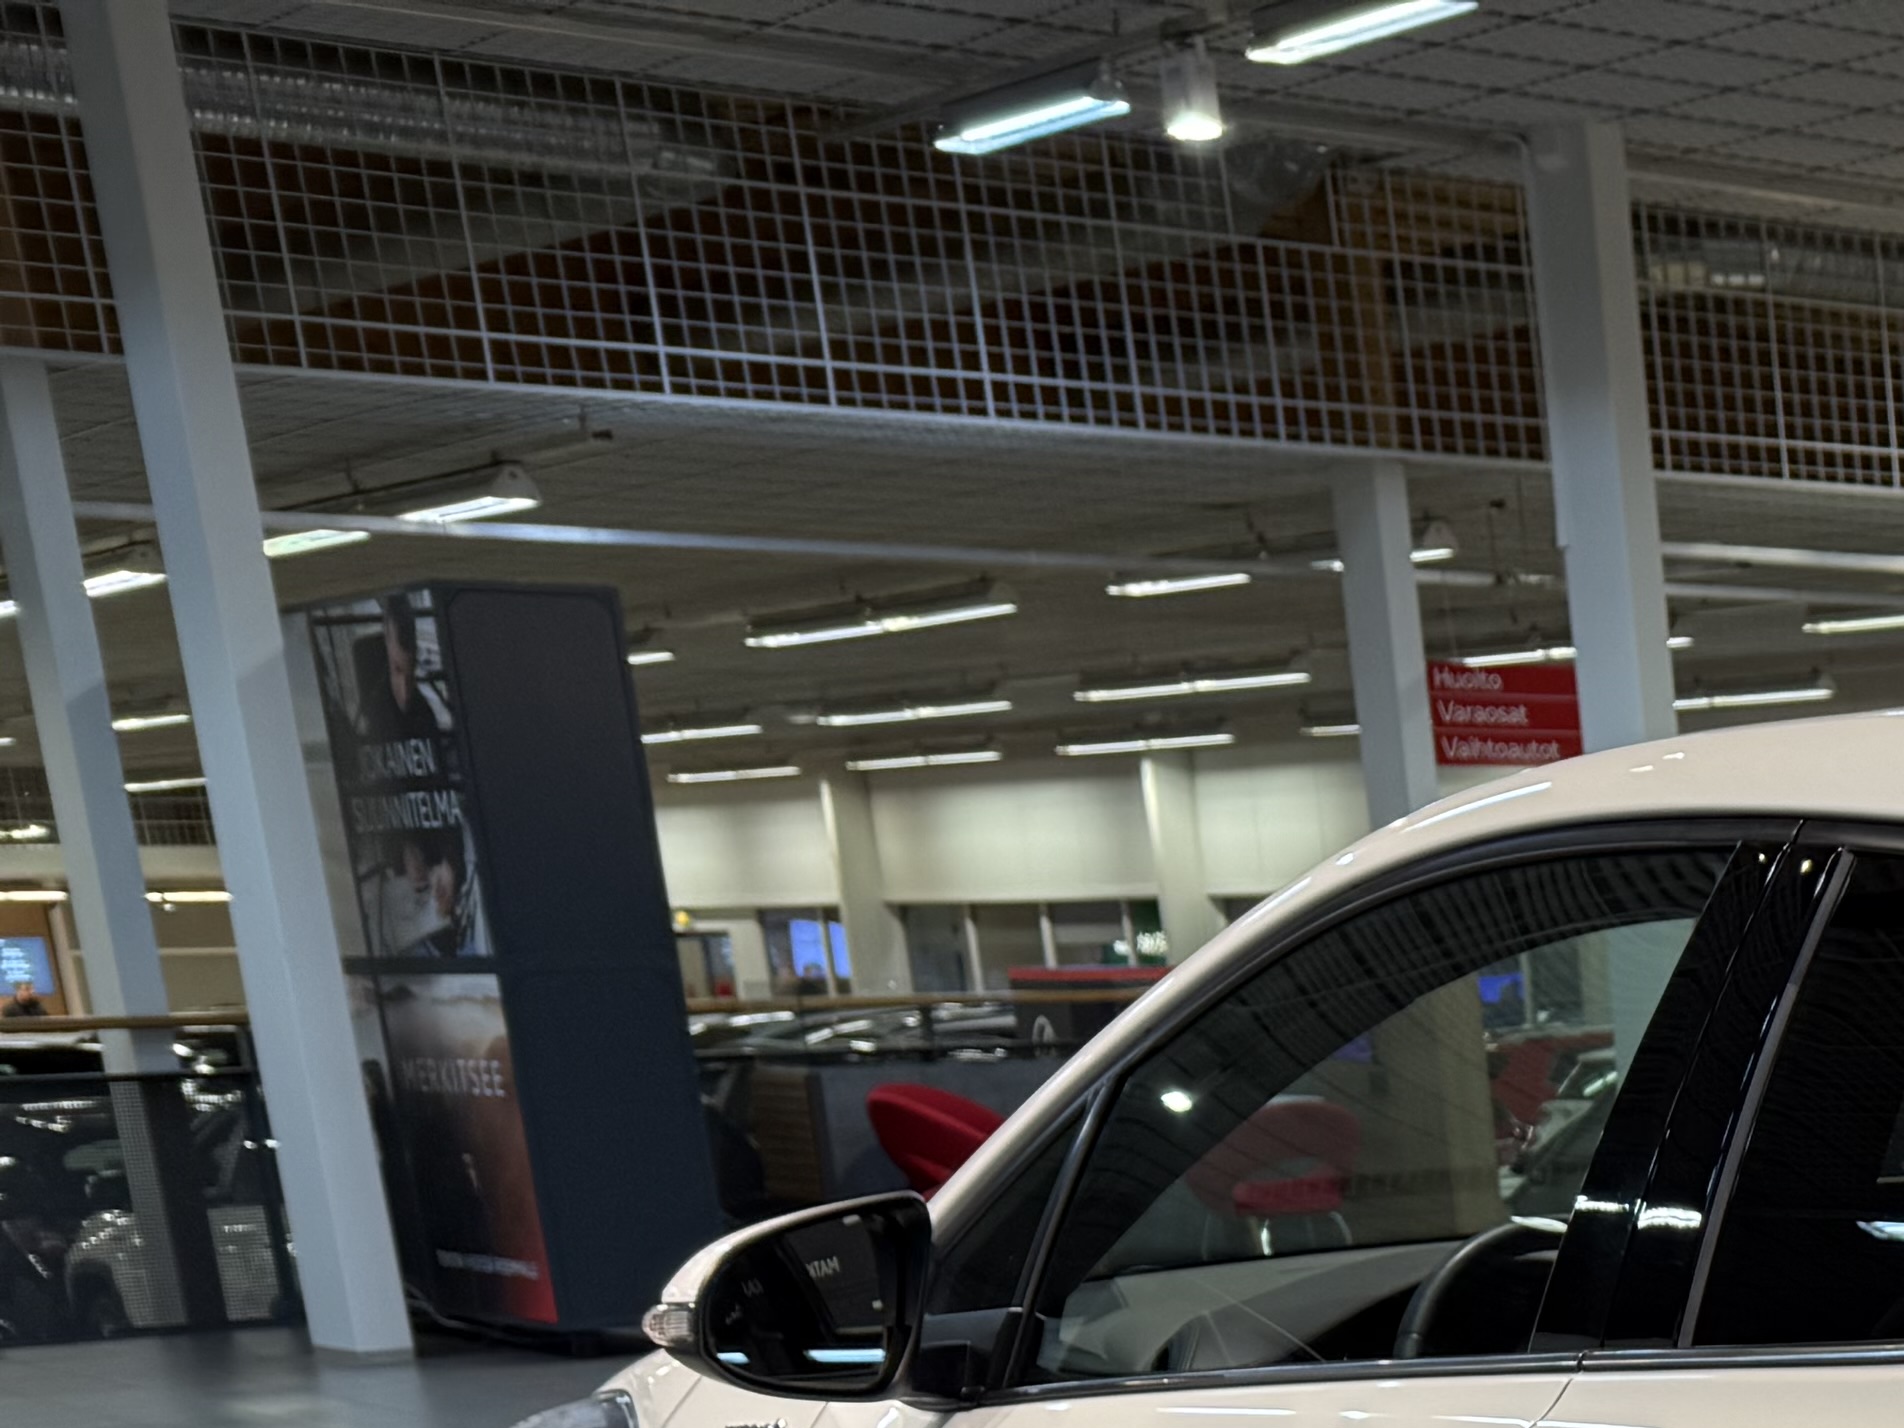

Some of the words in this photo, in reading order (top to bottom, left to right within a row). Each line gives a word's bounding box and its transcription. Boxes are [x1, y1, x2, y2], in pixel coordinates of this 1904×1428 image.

[1433, 668, 1503, 690] Huolto
[1438, 700, 1528, 725] Varaosat
[1441, 736, 1560, 760] Vaihtoautot
